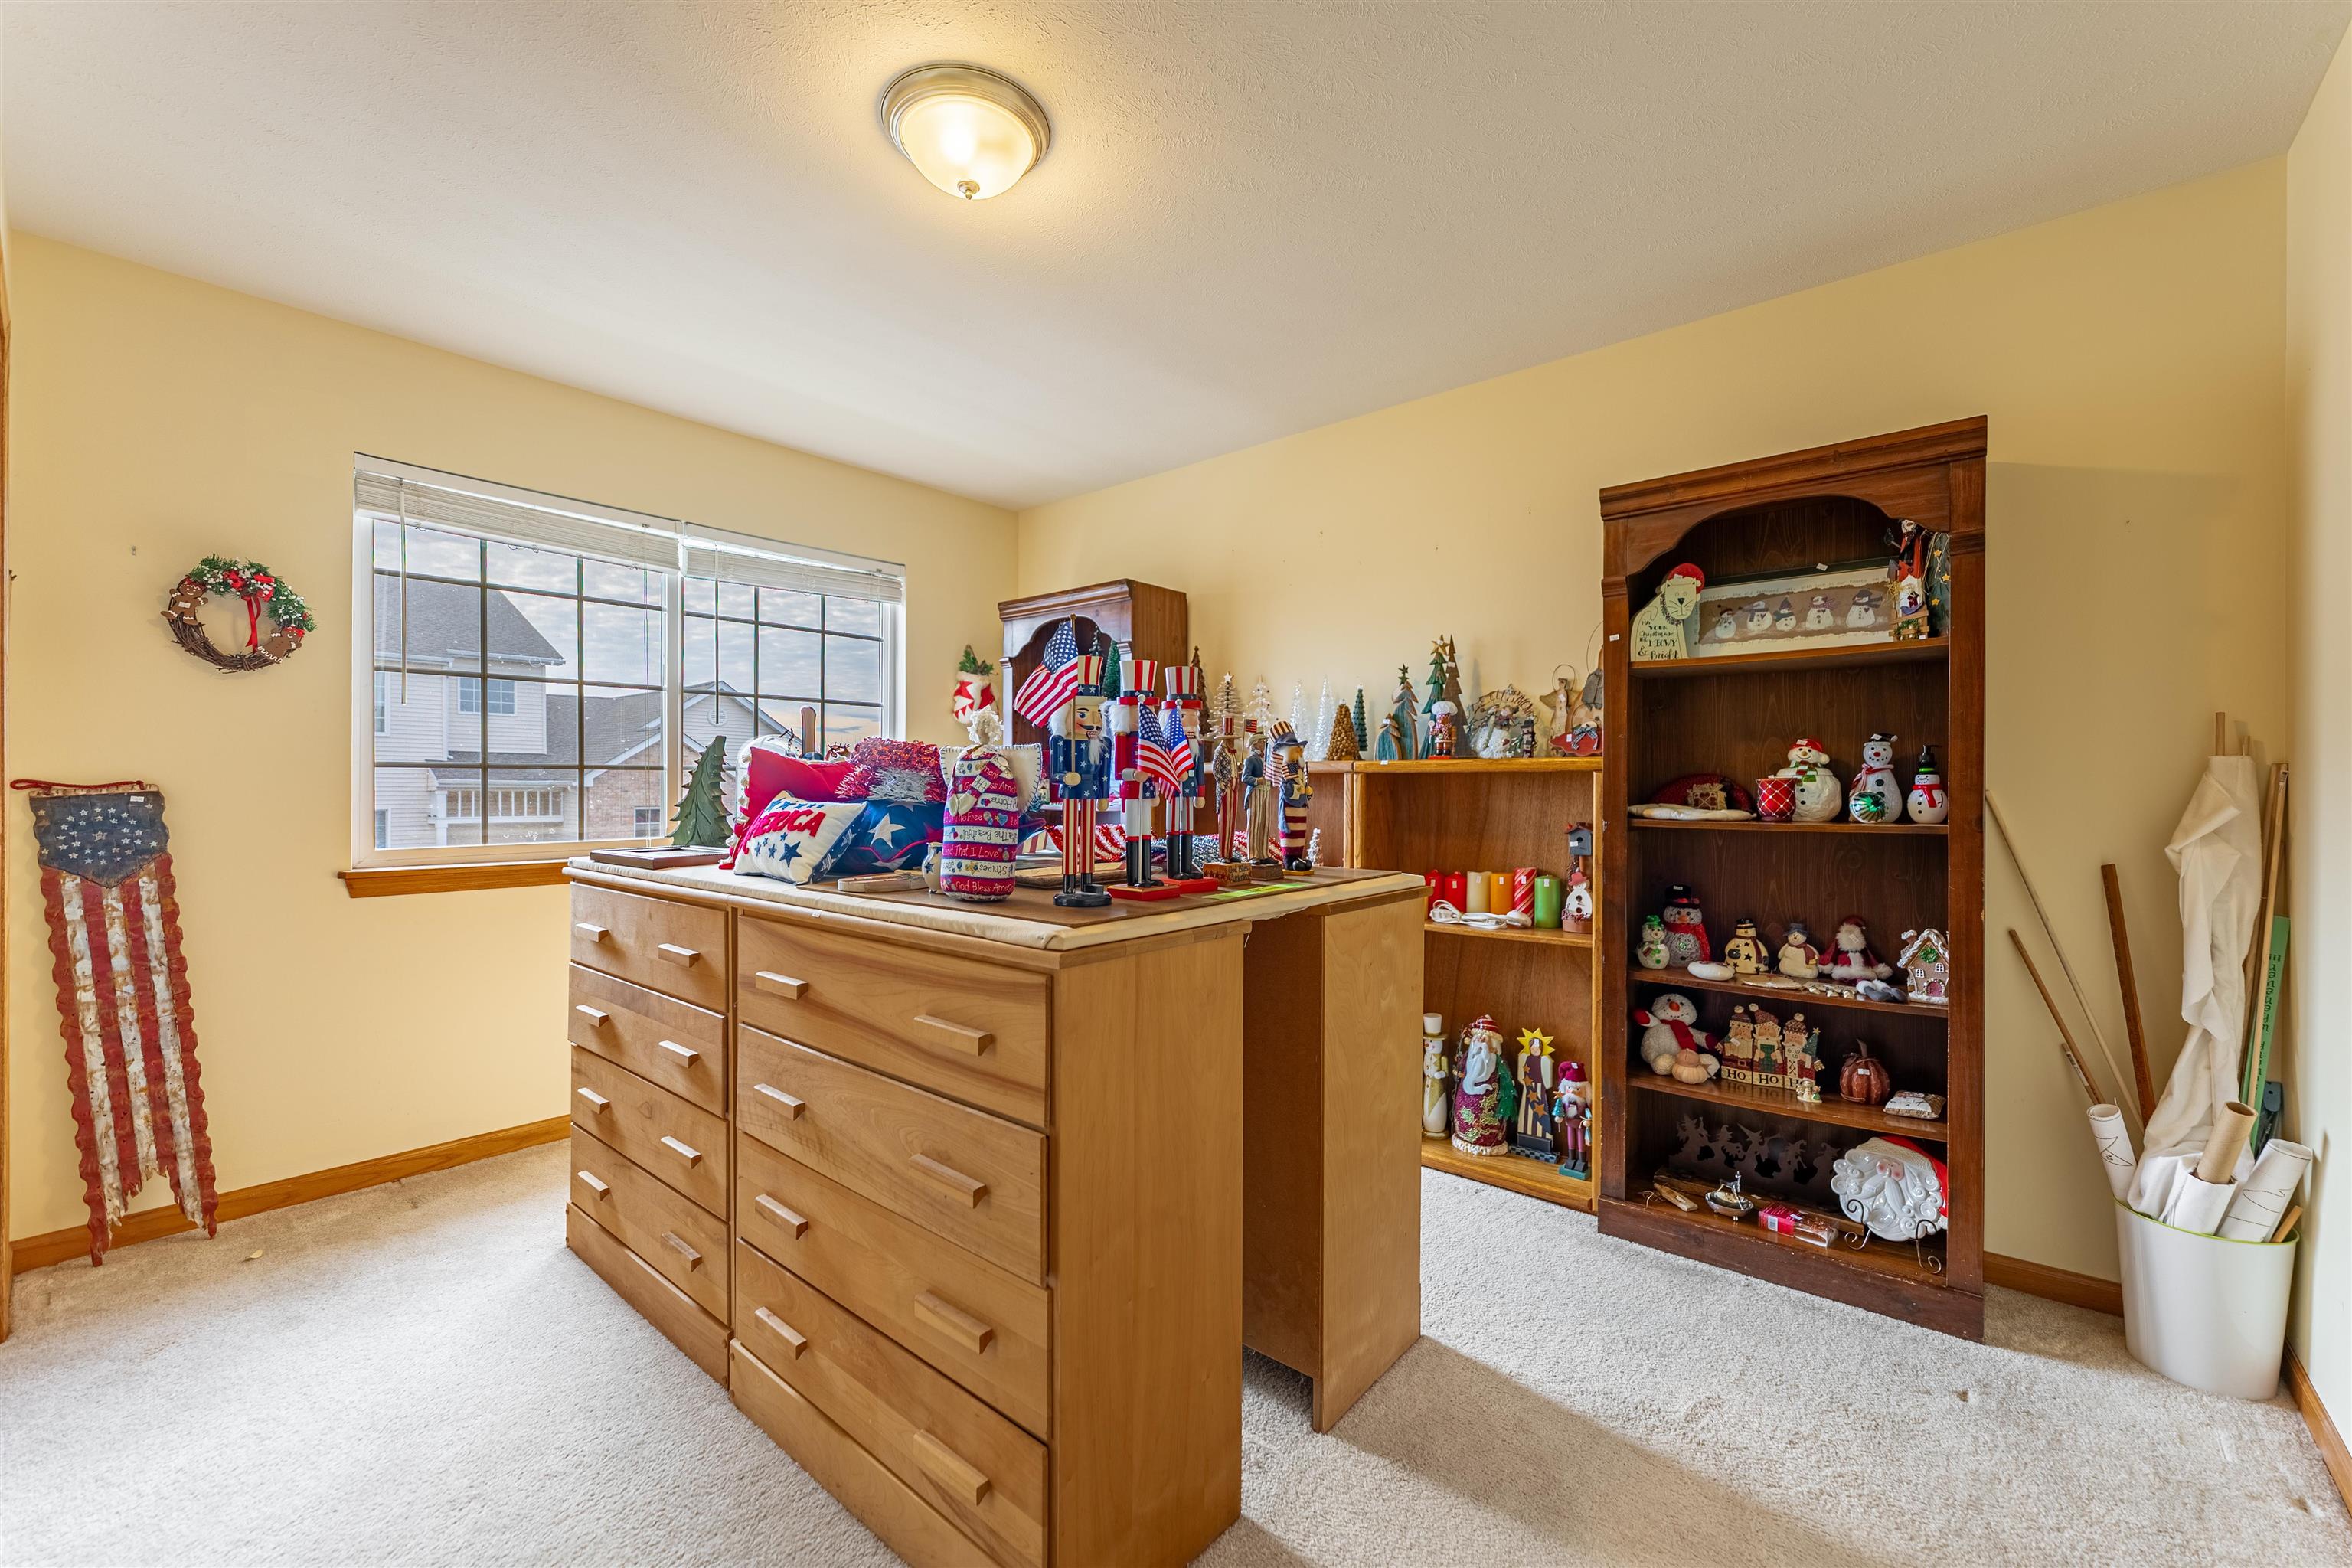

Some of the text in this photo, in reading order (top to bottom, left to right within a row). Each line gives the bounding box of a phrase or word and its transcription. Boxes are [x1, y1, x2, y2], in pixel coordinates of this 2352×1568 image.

[1648, 639, 1677, 648] MEOWY
[1638, 645, 1678, 660] & Bright
[991, 796, 1011, 810] Home
[966, 812, 983, 822] Free
[963, 828, 992, 841] Beautiful
[995, 830, 1009, 841] The
[954, 844, 969, 857] That
[969, 847, 977, 857] I
[978, 846, 999, 858] Love
[979, 864, 1008, 876] Stripes
[956, 880, 969, 891] God
[972, 881, 991, 892] Bless
[1727, 1068, 1746, 1080] HO
[1758, 1073, 1779, 1085] HO
[1788, 1077, 1803, 1089] H
